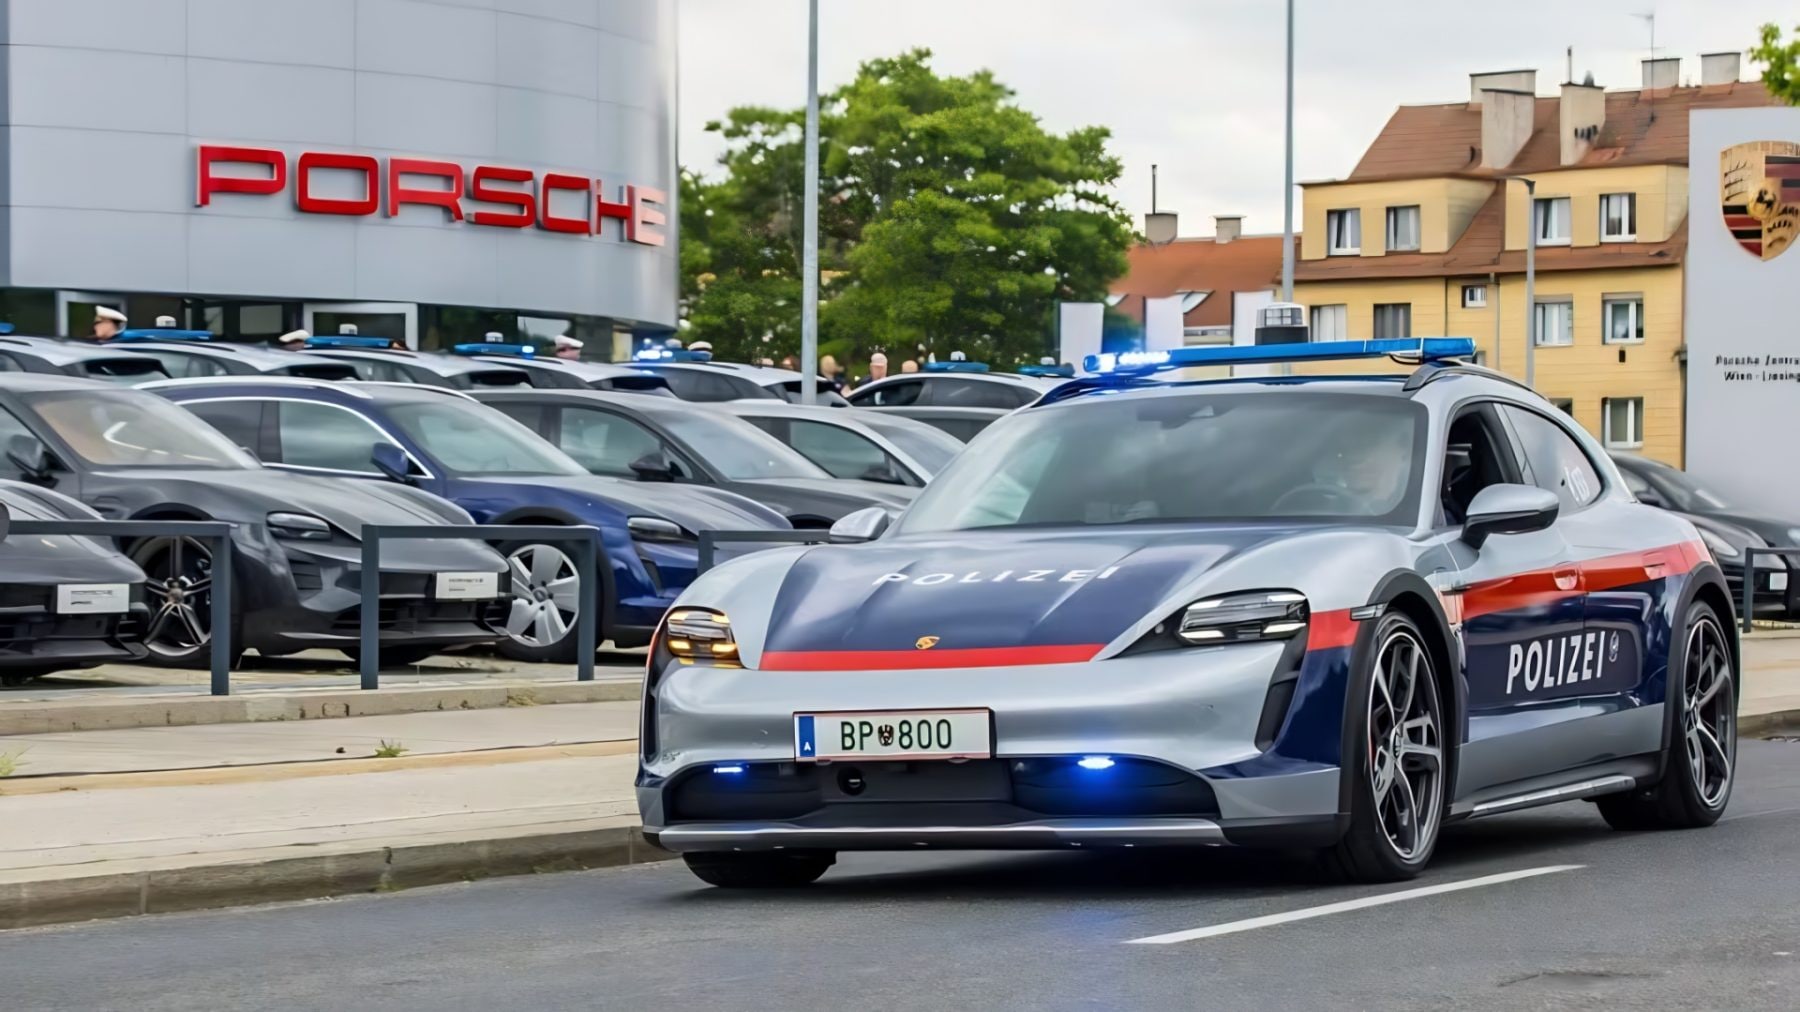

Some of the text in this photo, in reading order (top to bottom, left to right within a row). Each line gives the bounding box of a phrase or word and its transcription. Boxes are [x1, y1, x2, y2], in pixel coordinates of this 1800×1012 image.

[195, 144, 666, 247] PORSCHE
[871, 566, 1120, 586] POLIZEI
[1506, 630, 1606, 694] POLIZEI
[804, 741, 811, 751] A
[840, 718, 952, 751] BP 800
